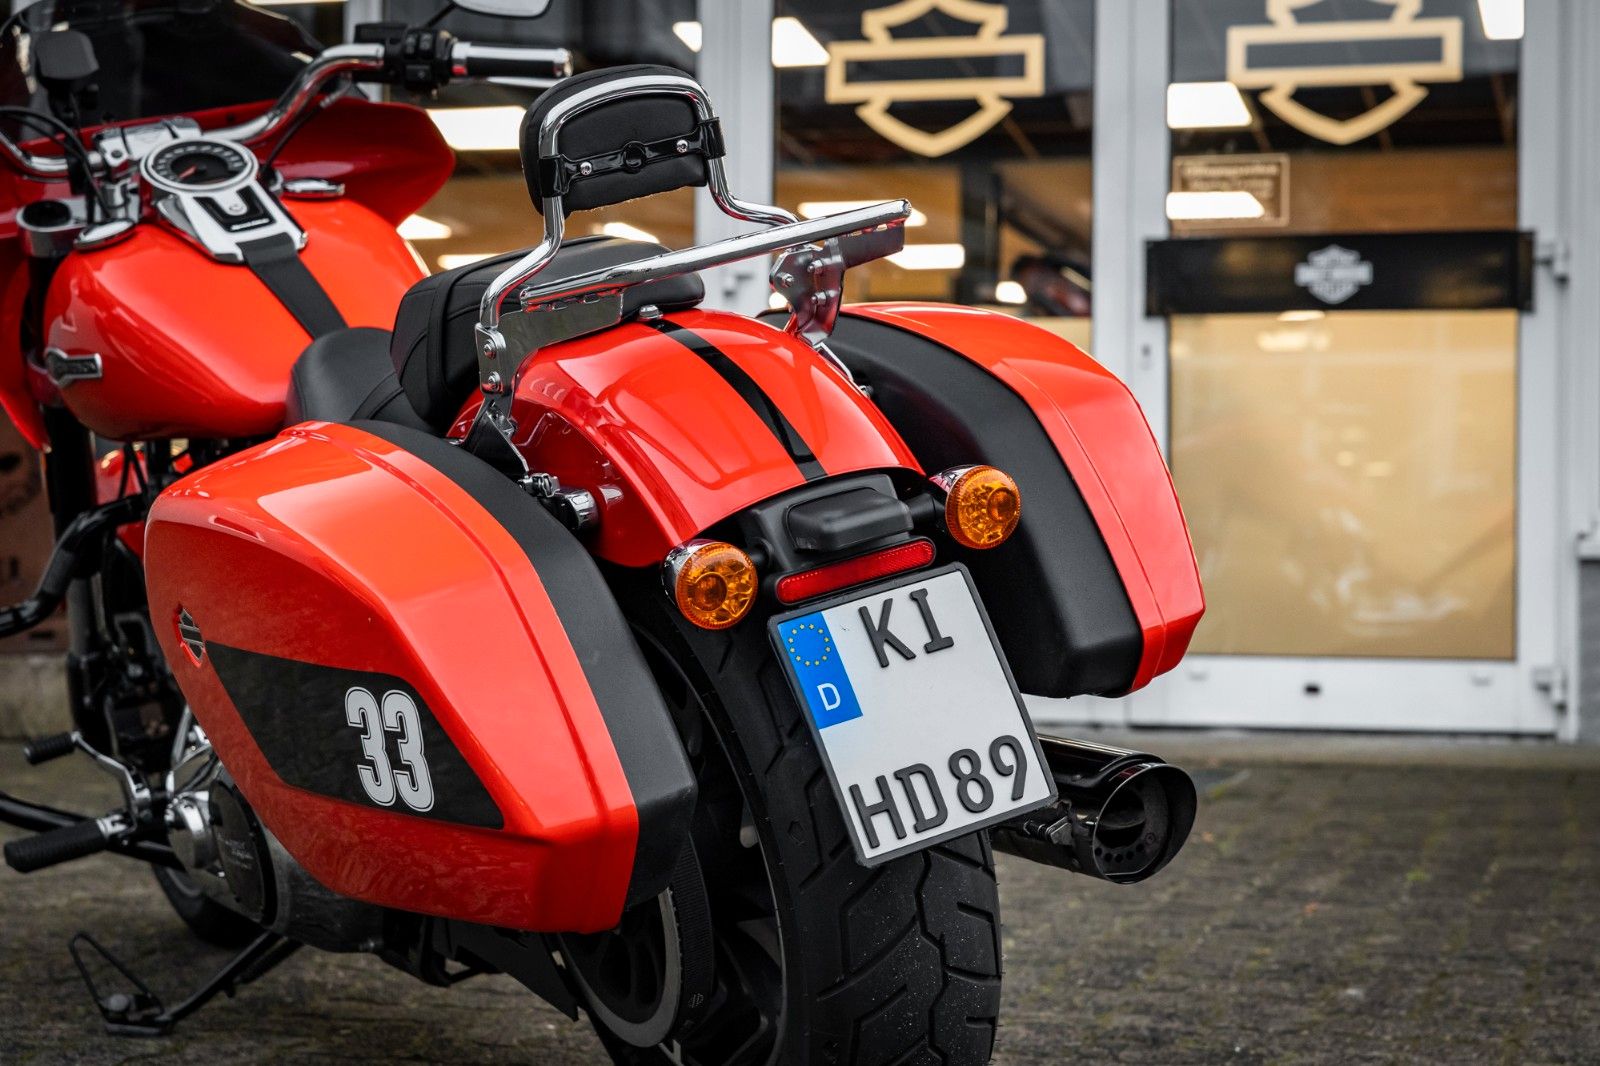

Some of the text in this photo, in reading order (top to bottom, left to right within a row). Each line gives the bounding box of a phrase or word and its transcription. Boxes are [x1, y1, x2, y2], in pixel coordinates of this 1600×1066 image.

[858, 588, 955, 668] KI
[816, 682, 841, 711] D
[344, 686, 435, 812] 33
